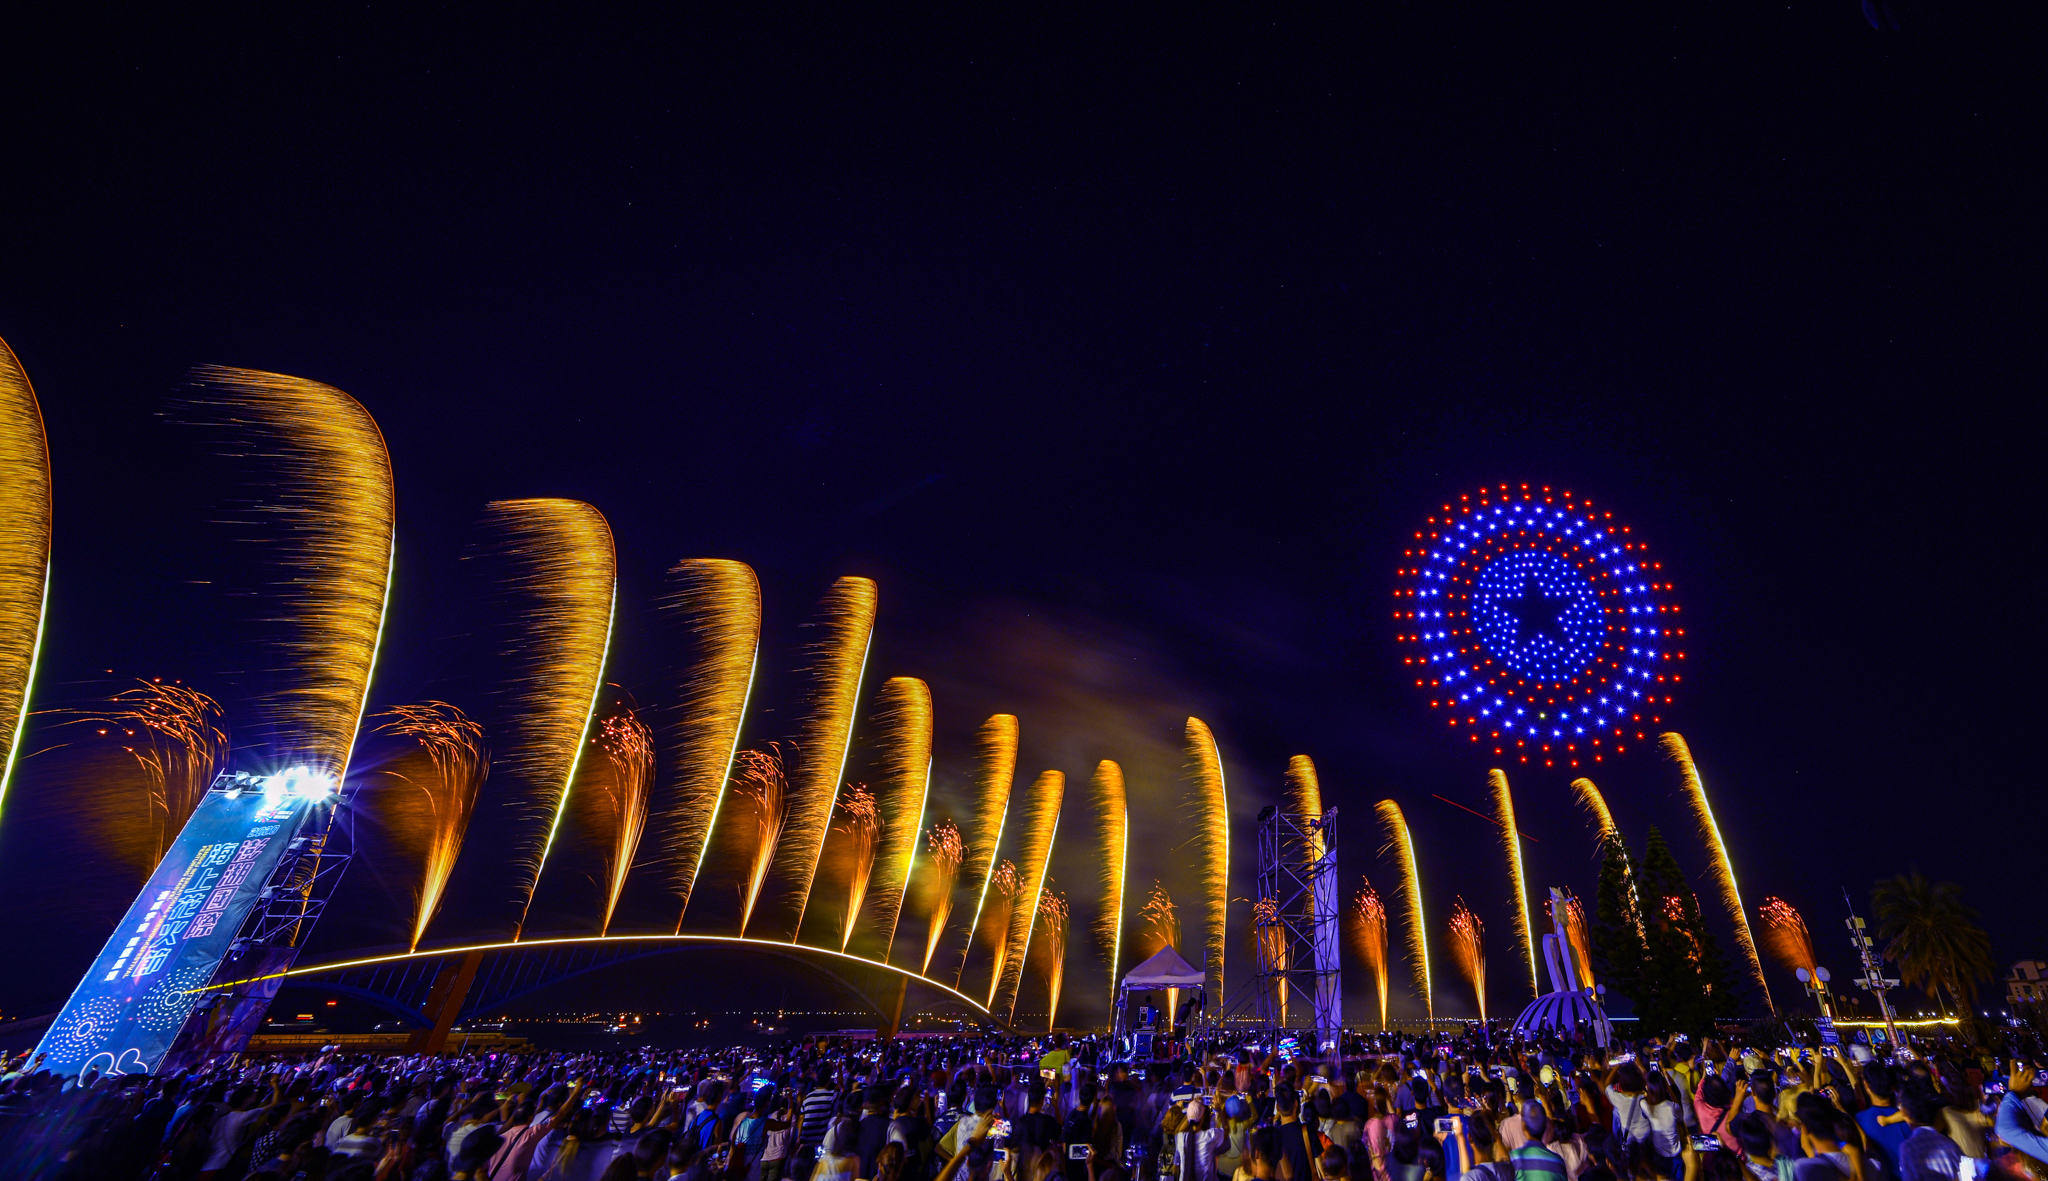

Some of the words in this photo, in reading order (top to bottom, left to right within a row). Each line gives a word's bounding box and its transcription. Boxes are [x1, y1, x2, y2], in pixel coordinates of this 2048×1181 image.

[246, 824, 281, 837] 2020
[131, 842, 239, 977] 海上花火節
[182, 838, 270, 940] 澎湖國際
